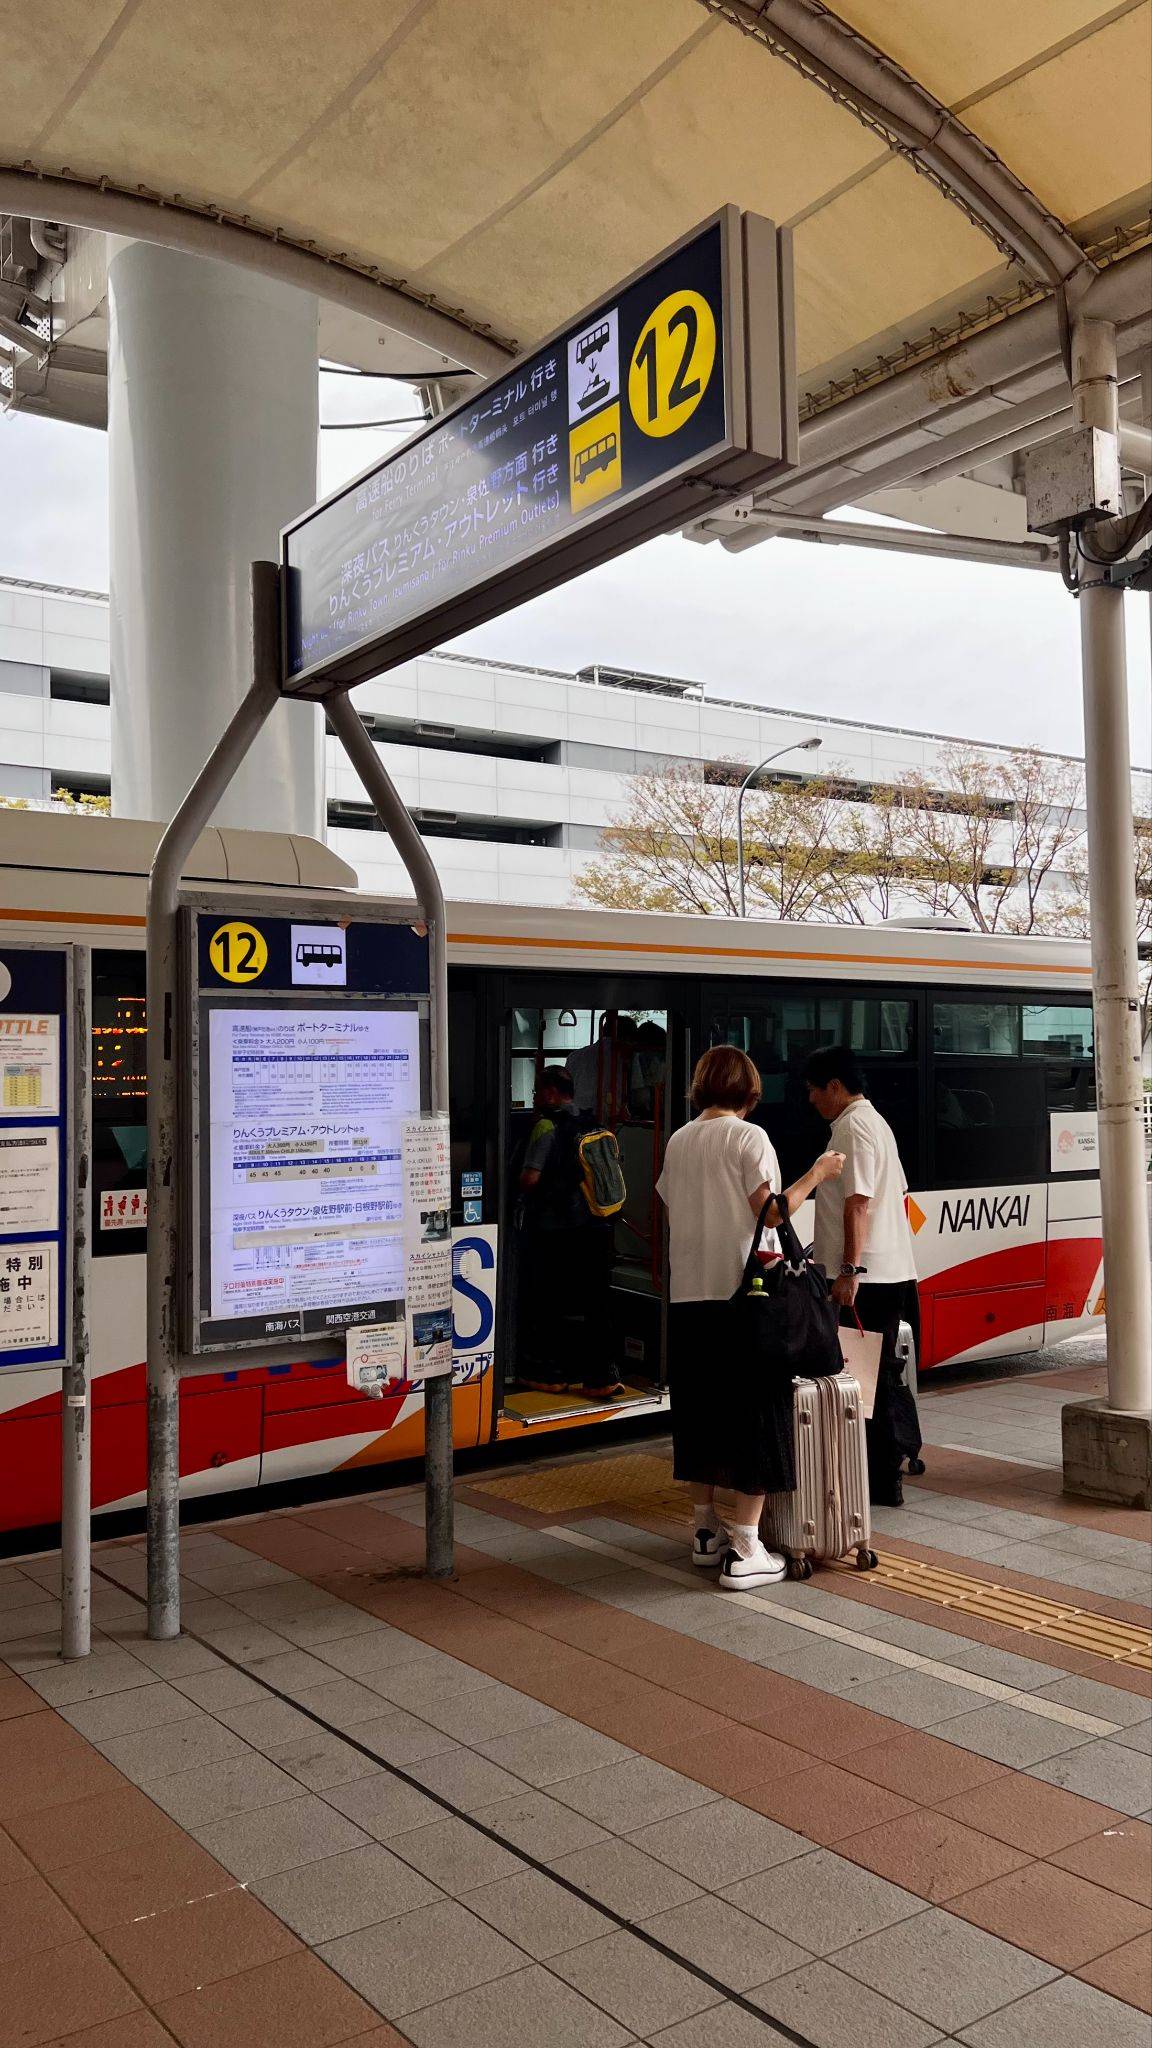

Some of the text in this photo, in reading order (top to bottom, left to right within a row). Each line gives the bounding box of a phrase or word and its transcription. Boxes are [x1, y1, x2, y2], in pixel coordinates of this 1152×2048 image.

[635, 304, 701, 424] 12
[356, 358, 557, 513] 高速船のりば ポートターミナル 行き
[341, 538, 390, 585] 深夜バス
[394, 450, 528, 550] りんくうタウン・泉佐野方面
[531, 433, 558, 466] 行き
[329, 481, 528, 615] りんくうプレミアム・アウトレット
[532, 463, 559, 494] 行き
[479, 519, 518, 550] Premium
[214, 931, 259, 973] 12
[938, 1194, 1030, 1234] NANKAI
[6, 1255, 43, 1273] 特別
[265, 1319, 301, 1332] 南海バス
[325, 1309, 377, 1325] 関西空港交通
